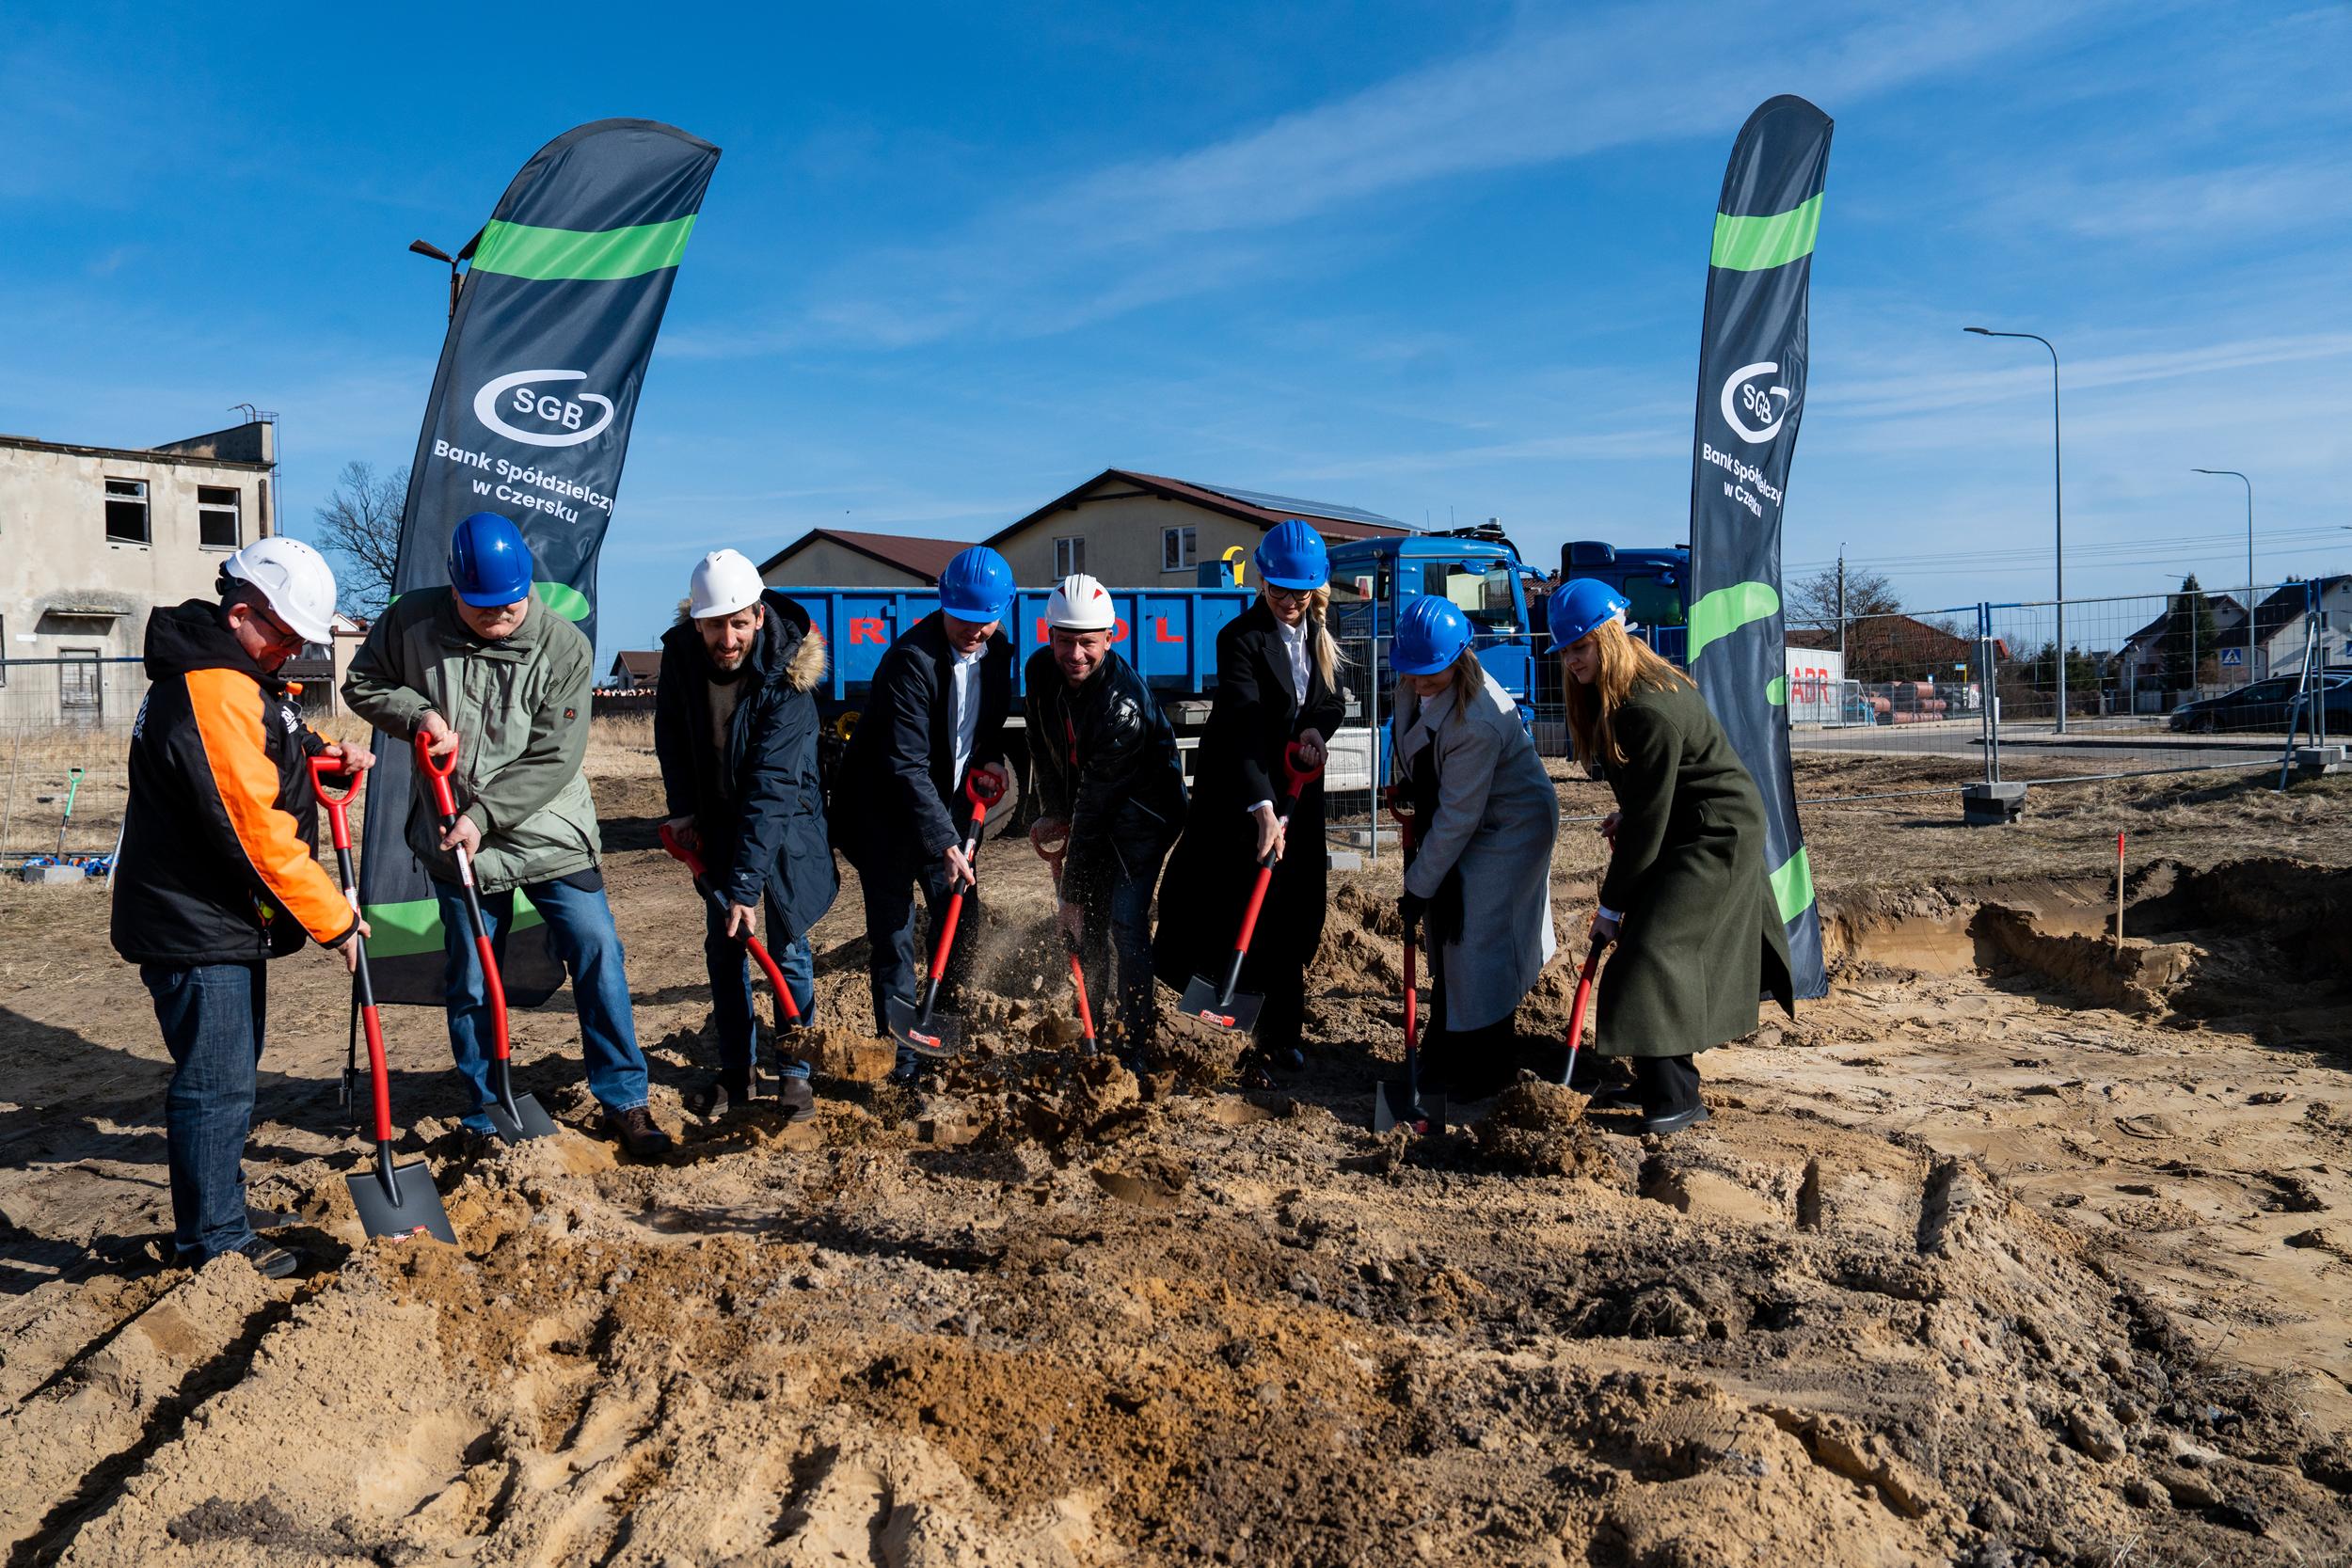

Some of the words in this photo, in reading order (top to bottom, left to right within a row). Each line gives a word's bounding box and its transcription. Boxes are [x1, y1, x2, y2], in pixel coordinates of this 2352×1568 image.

[513, 388, 583, 430] SGB
[1742, 383, 1772, 424] SGB
[434, 439, 491, 471] Bank
[495, 459, 614, 517] Spółdzielczy
[1703, 443, 1733, 472] Bank
[472, 480, 491, 496] w
[495, 485, 579, 524] Czersku
[1724, 482, 1733, 498] w
[1735, 485, 1762, 517] Czeku
